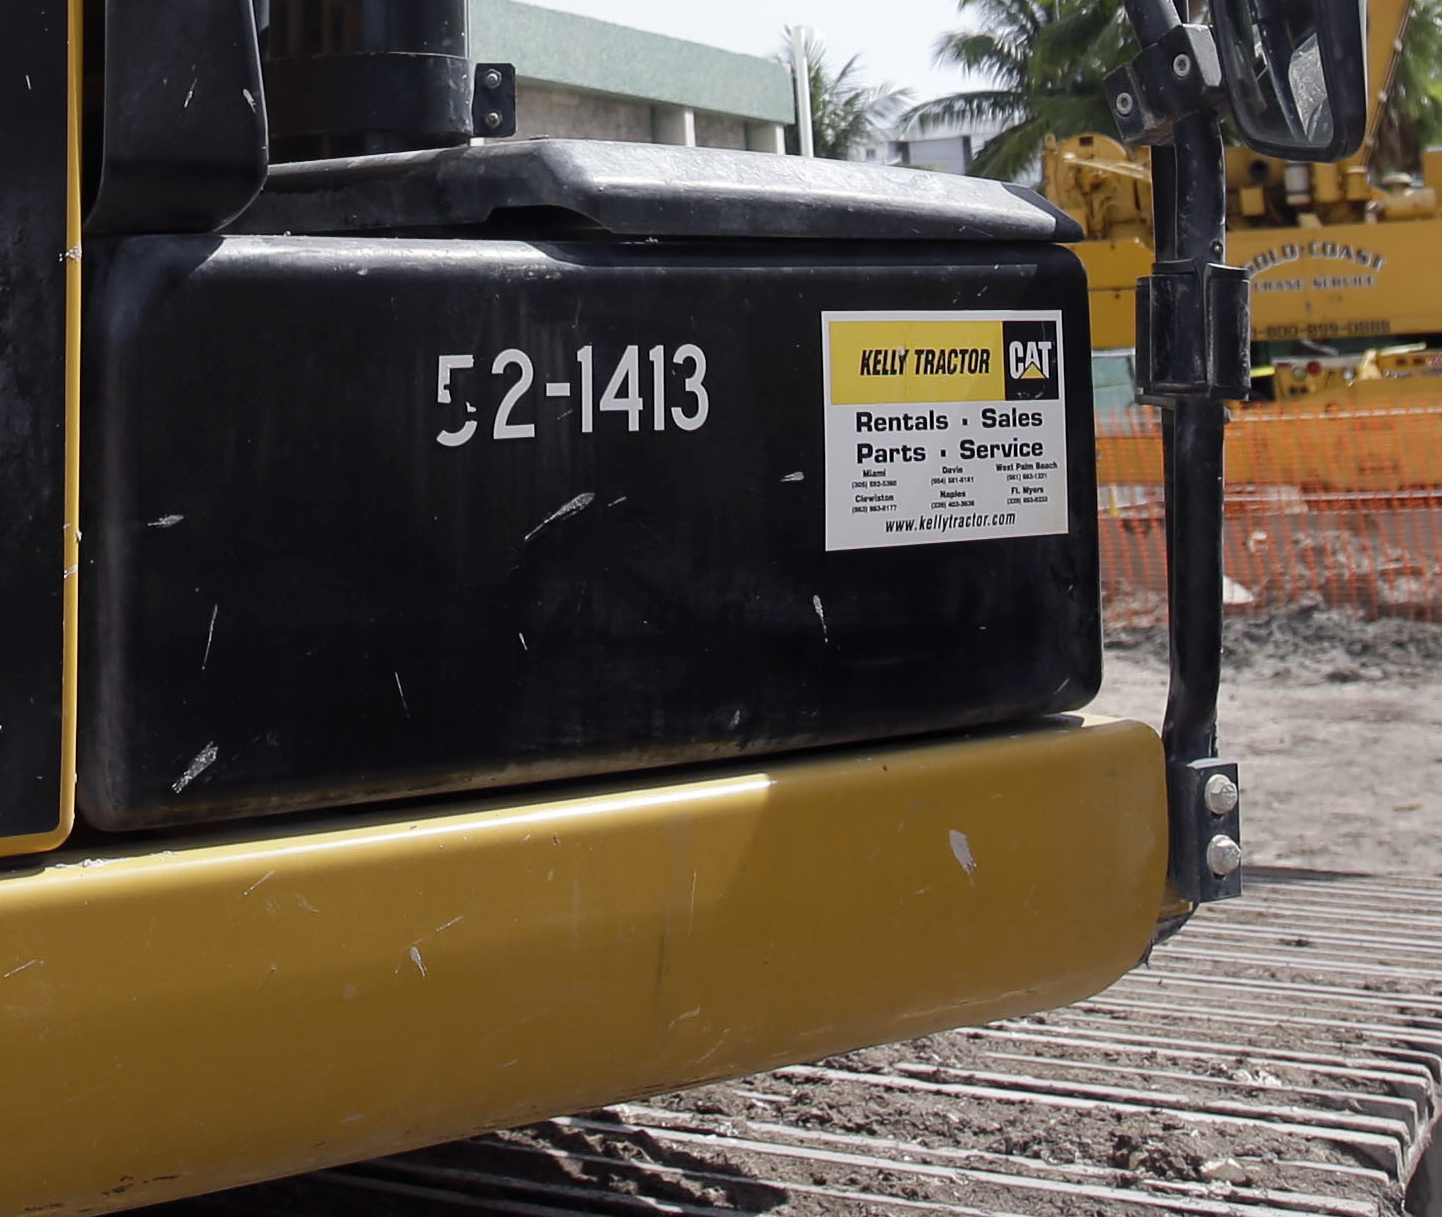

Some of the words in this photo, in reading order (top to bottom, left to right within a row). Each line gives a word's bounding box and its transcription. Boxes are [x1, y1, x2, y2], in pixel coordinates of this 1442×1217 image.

[1309, 241, 1388, 272] COAST
[860, 349, 909, 376] KELLY
[914, 348, 991, 375] TRACTOR
[1009, 341, 1053, 380] CAT
[856, 410, 949, 433] Rentals
[981, 407, 1043, 429] Sales
[856, 442, 926, 464] Parts
[960, 438, 1044, 460] Service
[885, 513, 1016, 533] www.kellytractor.com
